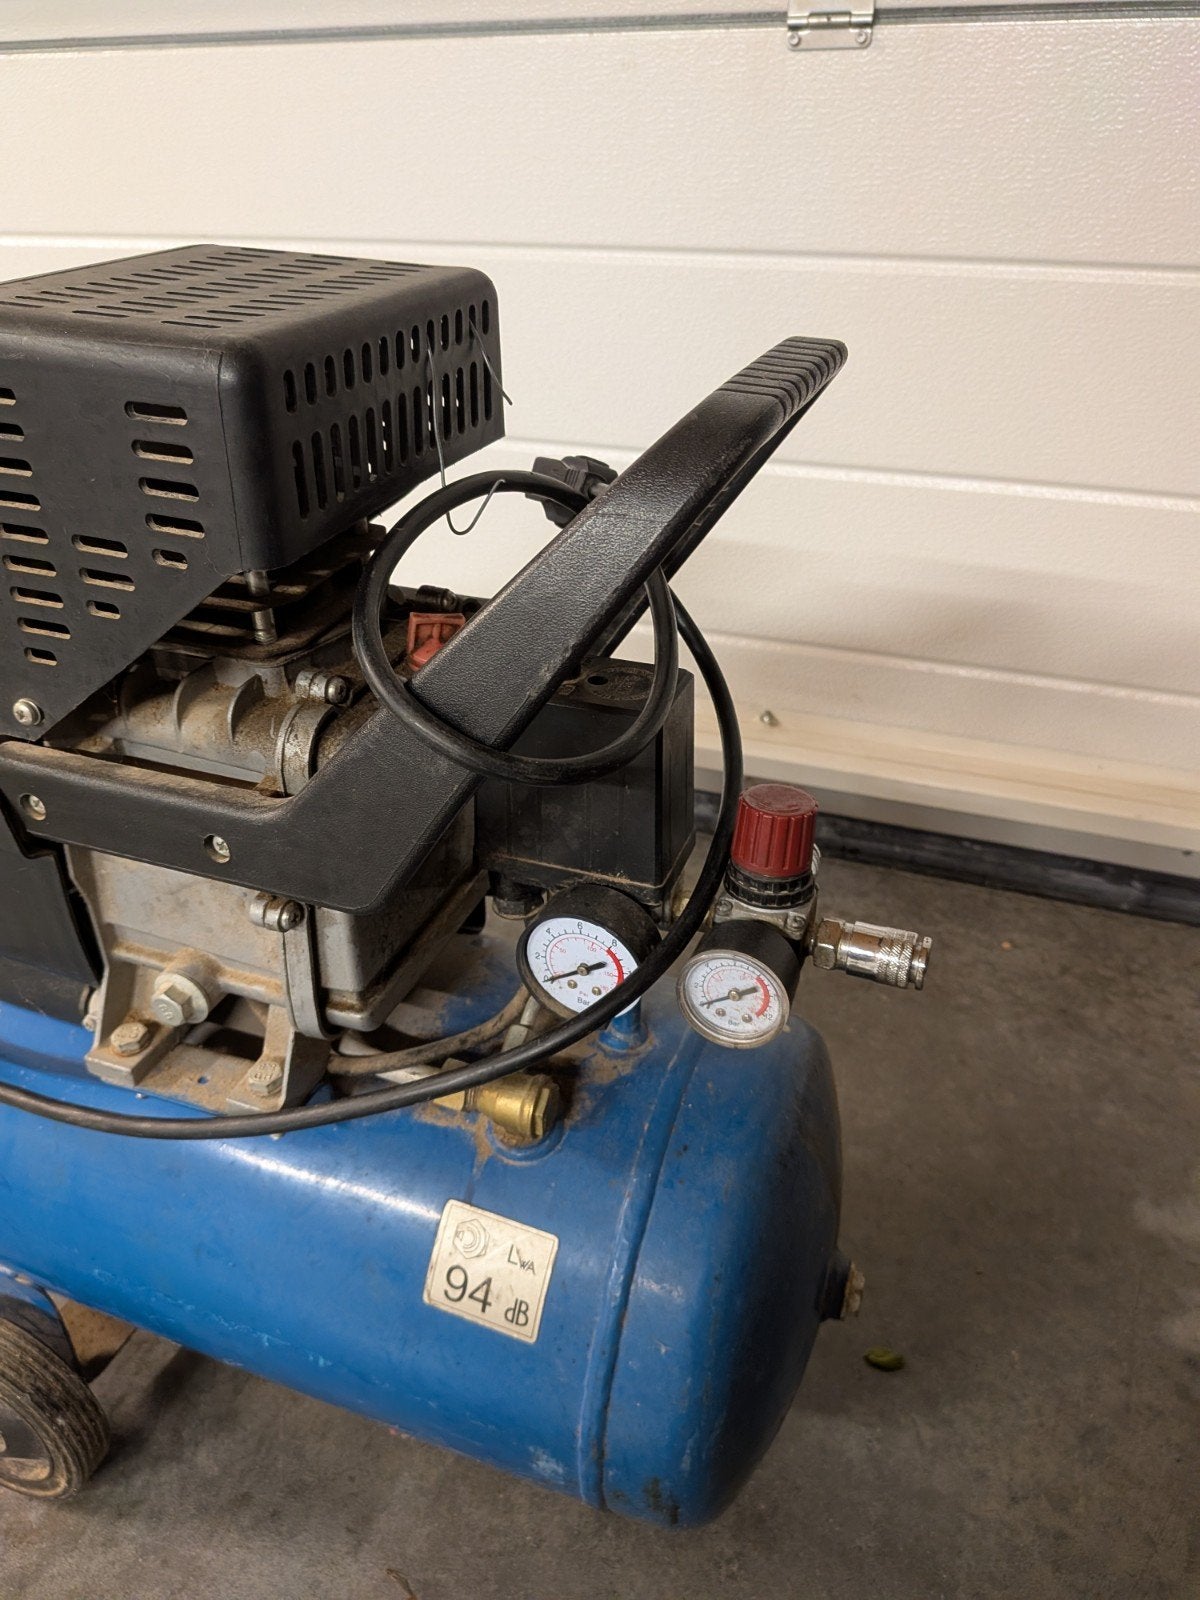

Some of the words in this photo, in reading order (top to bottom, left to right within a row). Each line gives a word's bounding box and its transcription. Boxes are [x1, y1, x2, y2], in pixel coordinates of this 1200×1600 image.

[577, 922, 583, 930] 6
[612, 939, 618, 947] 8
[535, 952, 541, 960] 2
[444, 1264, 493, 1314] 94
[504, 1298, 529, 1327] dB
